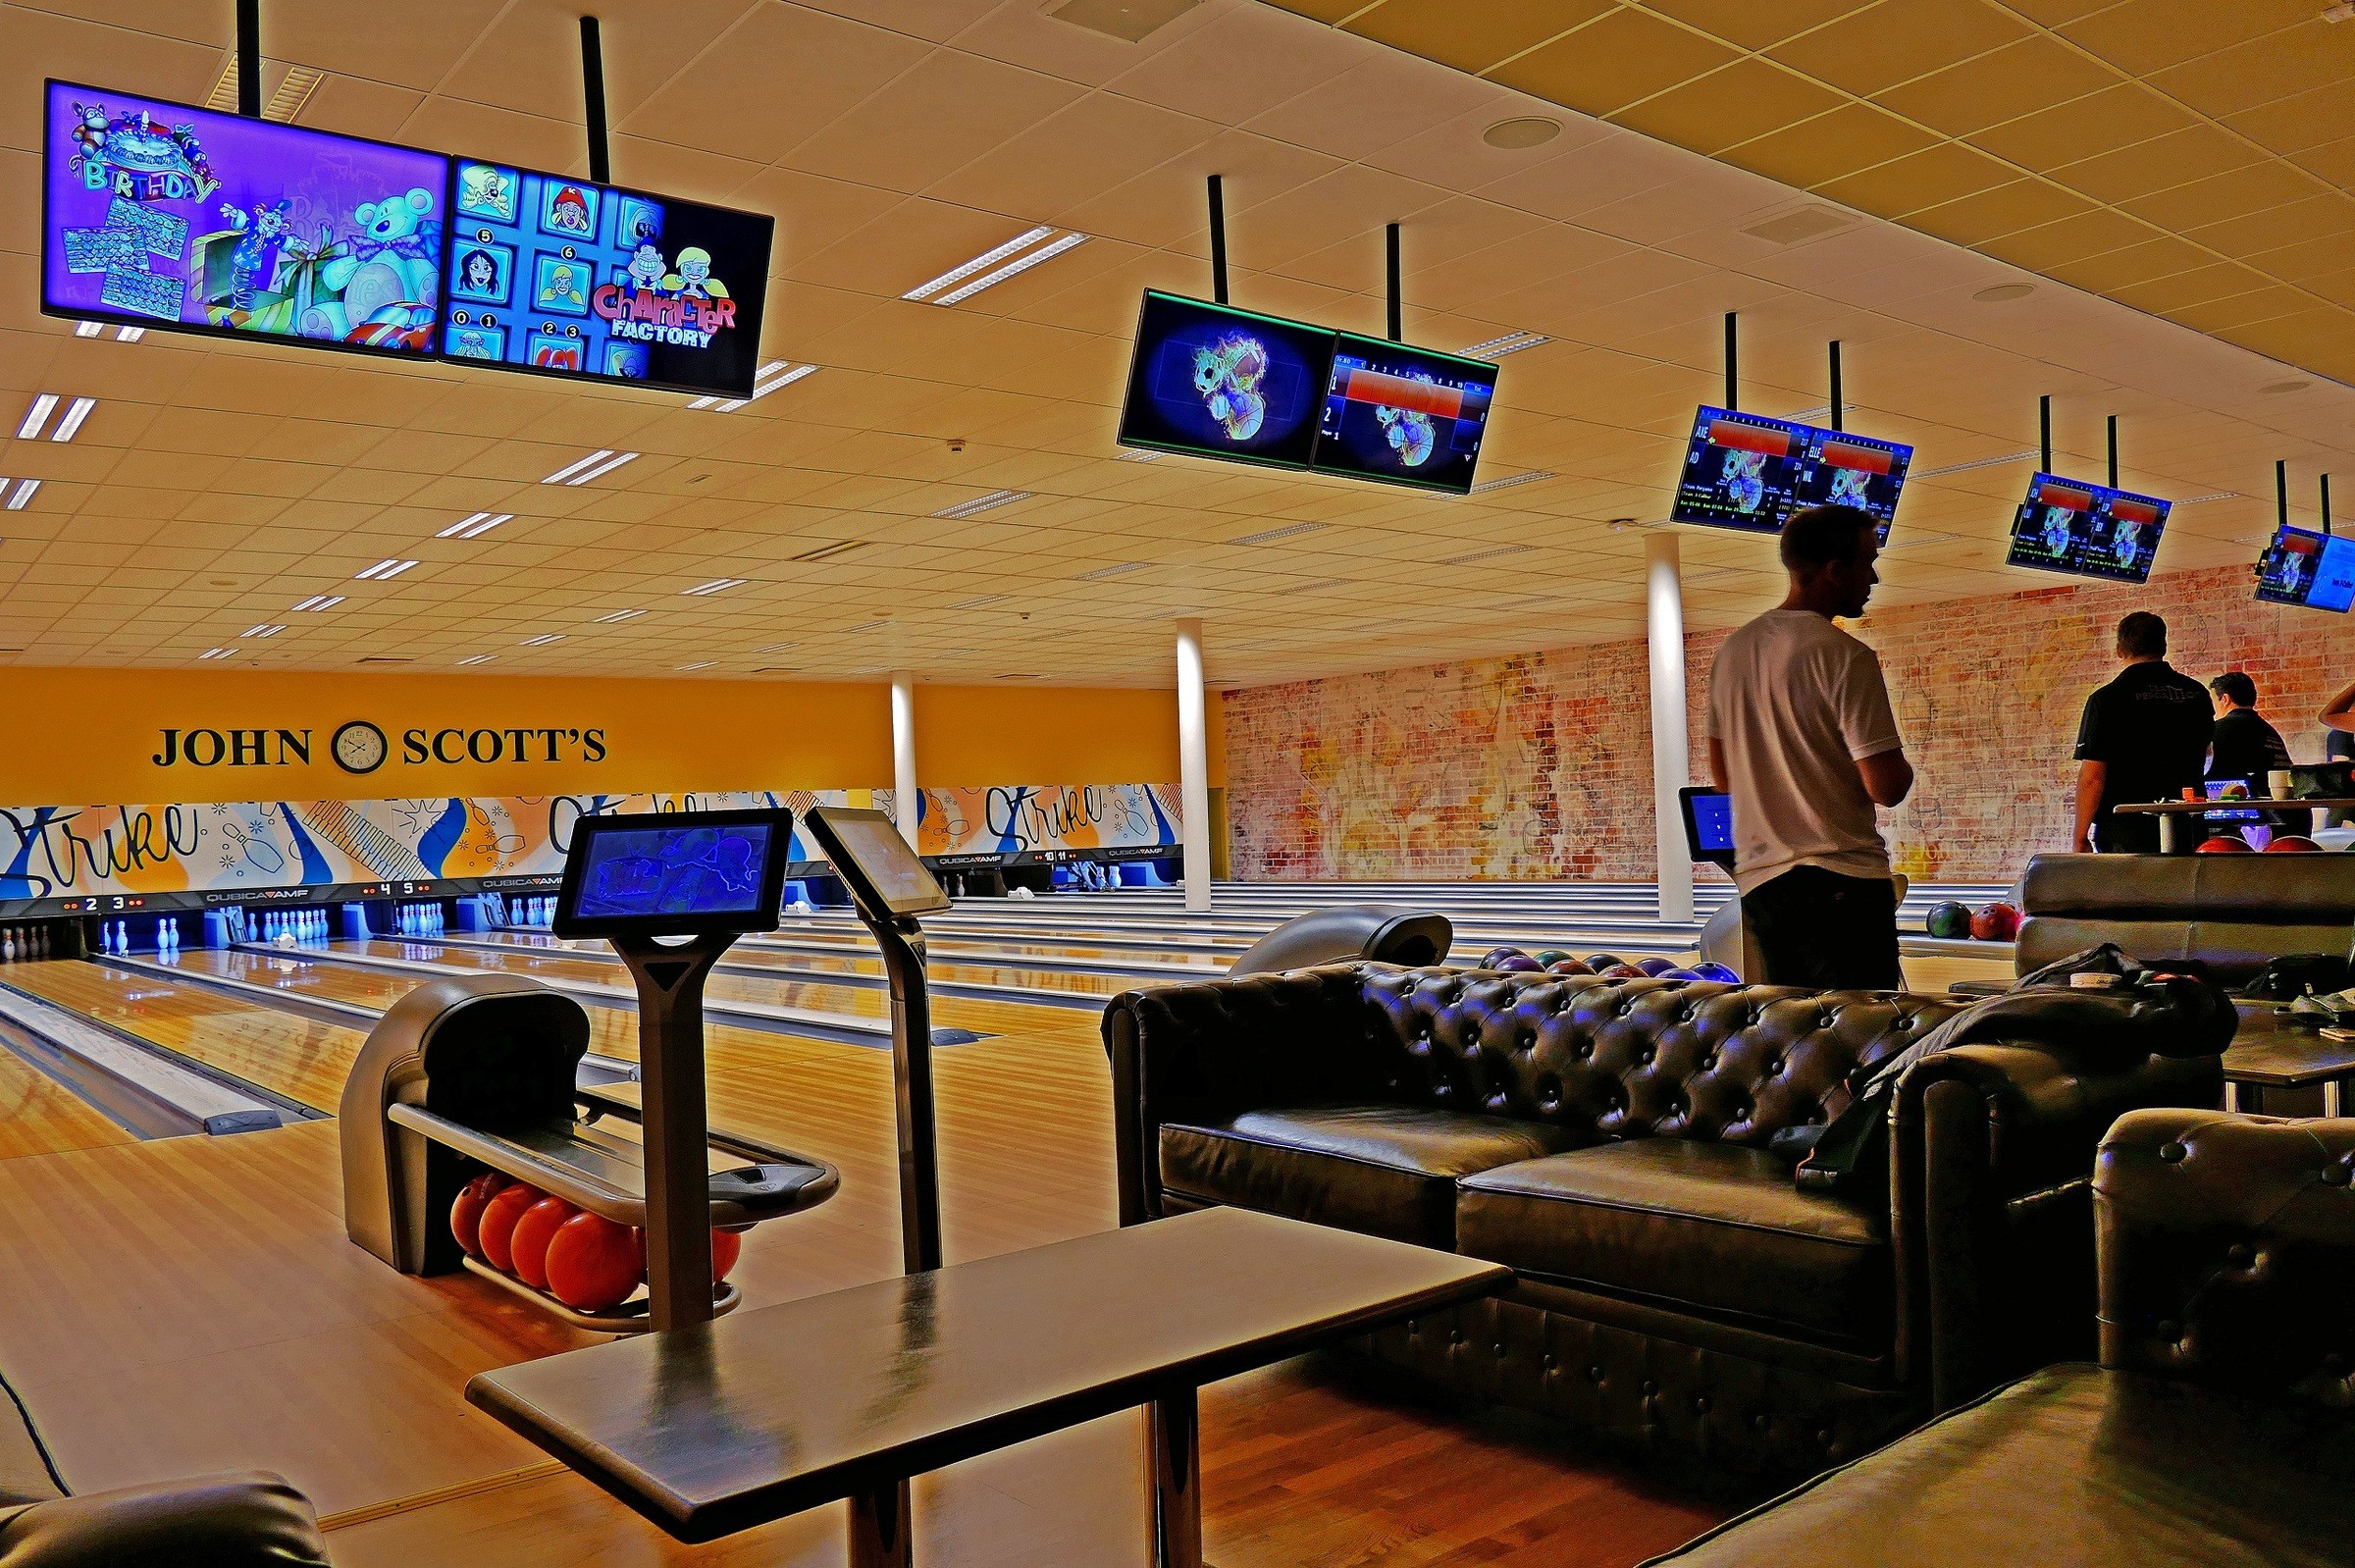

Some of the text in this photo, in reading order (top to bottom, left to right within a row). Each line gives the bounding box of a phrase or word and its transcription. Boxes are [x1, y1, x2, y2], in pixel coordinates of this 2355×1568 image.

[83, 160, 219, 204] BIRTHDAY
[611, 318, 713, 349] FACTORY
[1696, 425, 1709, 439] AXE
[1689, 452, 1700, 464] AD
[152, 728, 606, 767] JOHN SCOTT'S
[986, 785, 1103, 852] Strike
[1045, 852, 1066, 861] 10 11
[381, 883, 414, 895] 4 5
[86, 897, 124, 911] 2 3
